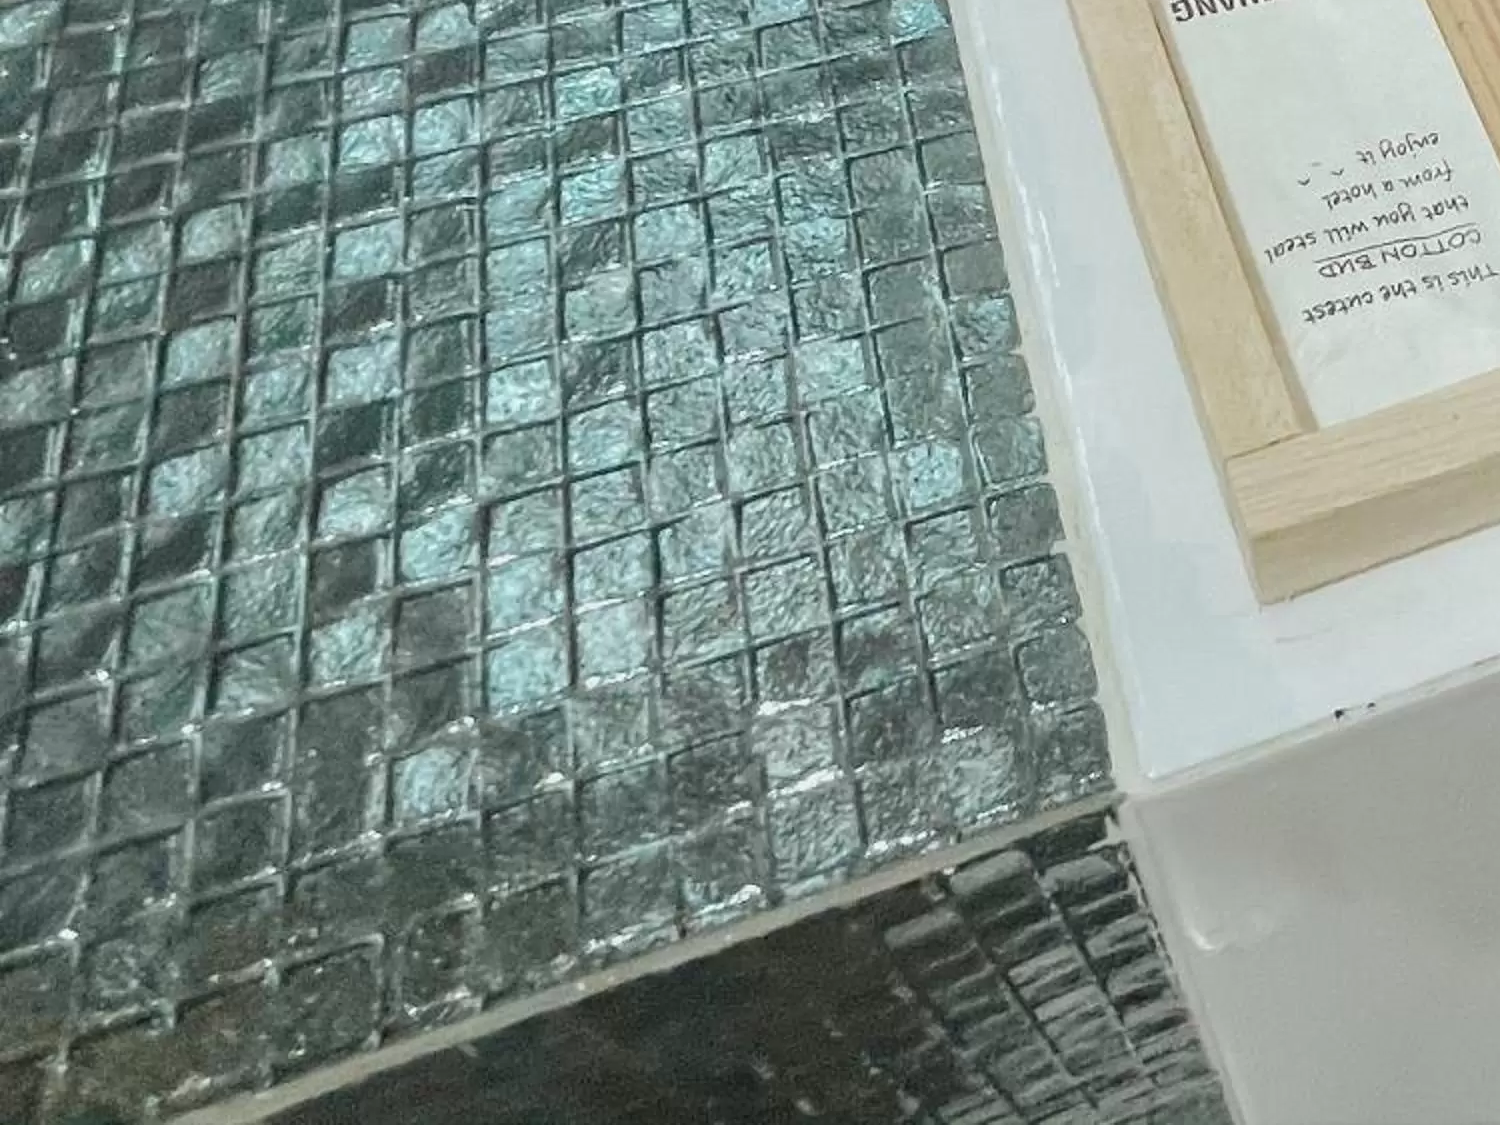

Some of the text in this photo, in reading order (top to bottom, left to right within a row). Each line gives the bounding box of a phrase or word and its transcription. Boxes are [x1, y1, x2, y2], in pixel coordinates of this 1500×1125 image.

[1355, 131, 1440, 166] enjoy it
[1321, 158, 1455, 211] from a hotel
[1264, 194, 1470, 264] that you will steal
[1318, 228, 1482, 279] COTTON BUD
[1302, 262, 1500, 325] This is the cutest
